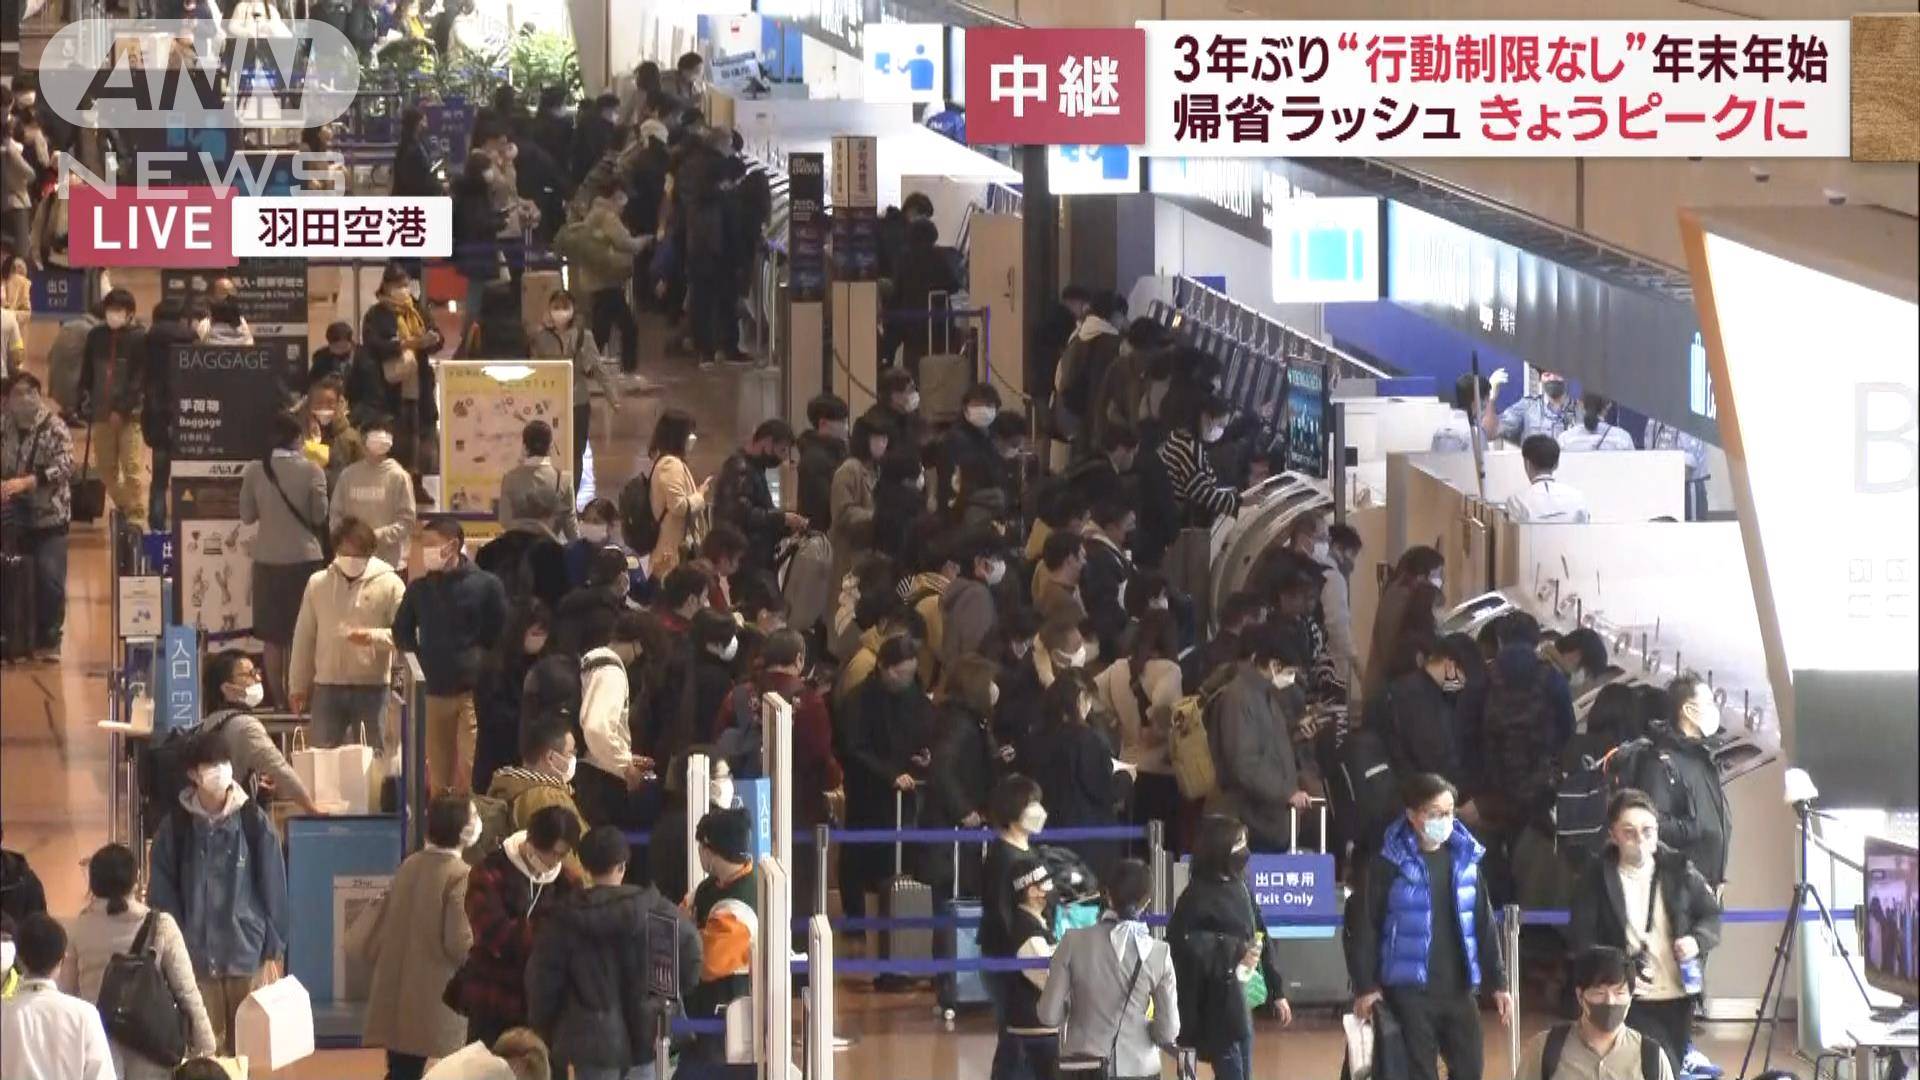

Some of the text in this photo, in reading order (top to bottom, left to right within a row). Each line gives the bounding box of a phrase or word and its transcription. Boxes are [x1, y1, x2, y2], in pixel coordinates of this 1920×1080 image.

[179, 350, 270, 369] BAGGAGE
[180, 399, 220, 413] 手荷物
[179, 417, 221, 429] Baggage
[171, 640, 191, 679] 入口
[1255, 872, 1314, 888] 出口専用
[1255, 892, 1314, 907] Exit Only
